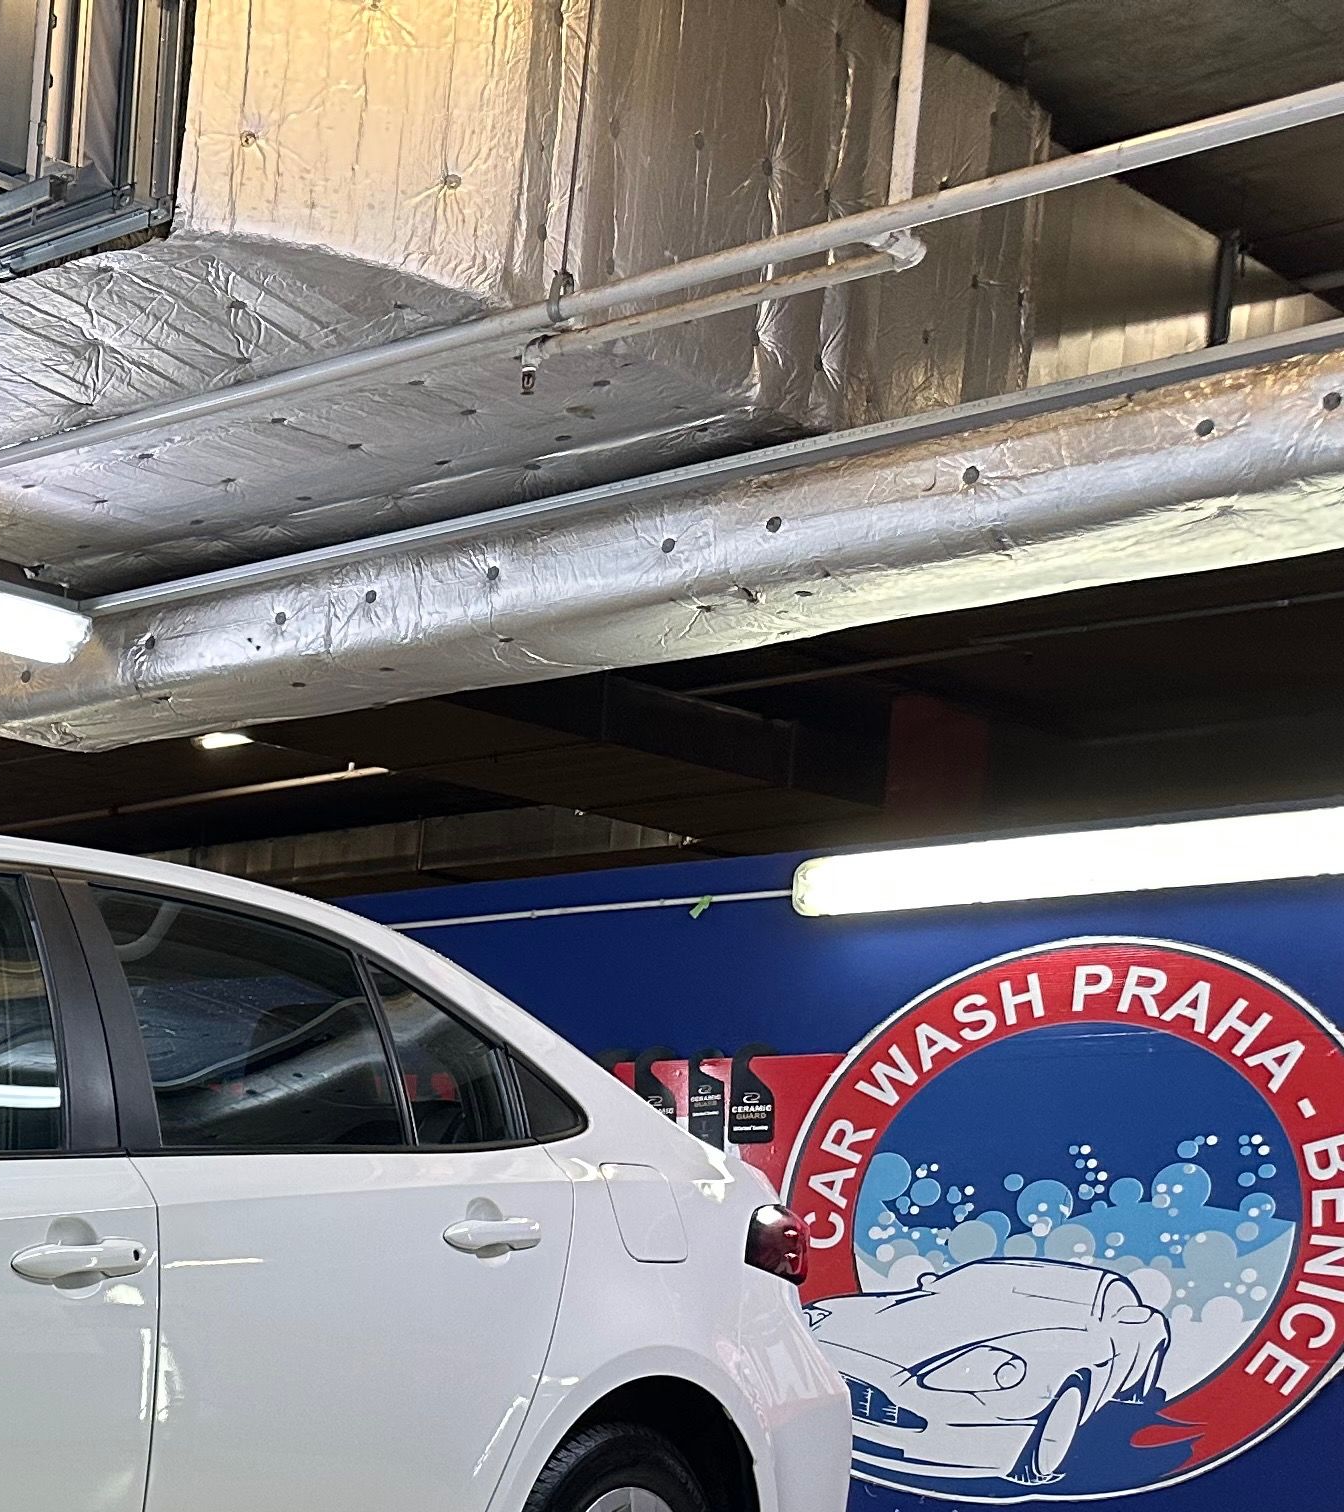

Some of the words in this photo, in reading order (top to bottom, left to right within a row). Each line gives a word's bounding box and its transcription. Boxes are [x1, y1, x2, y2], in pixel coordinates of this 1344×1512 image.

[803, 1118, 877, 1250] CAR
[854, 972, 1045, 1107] WASH
[1072, 964, 1308, 1094] PRAHA
[1244, 1133, 1344, 1396] BENICE
